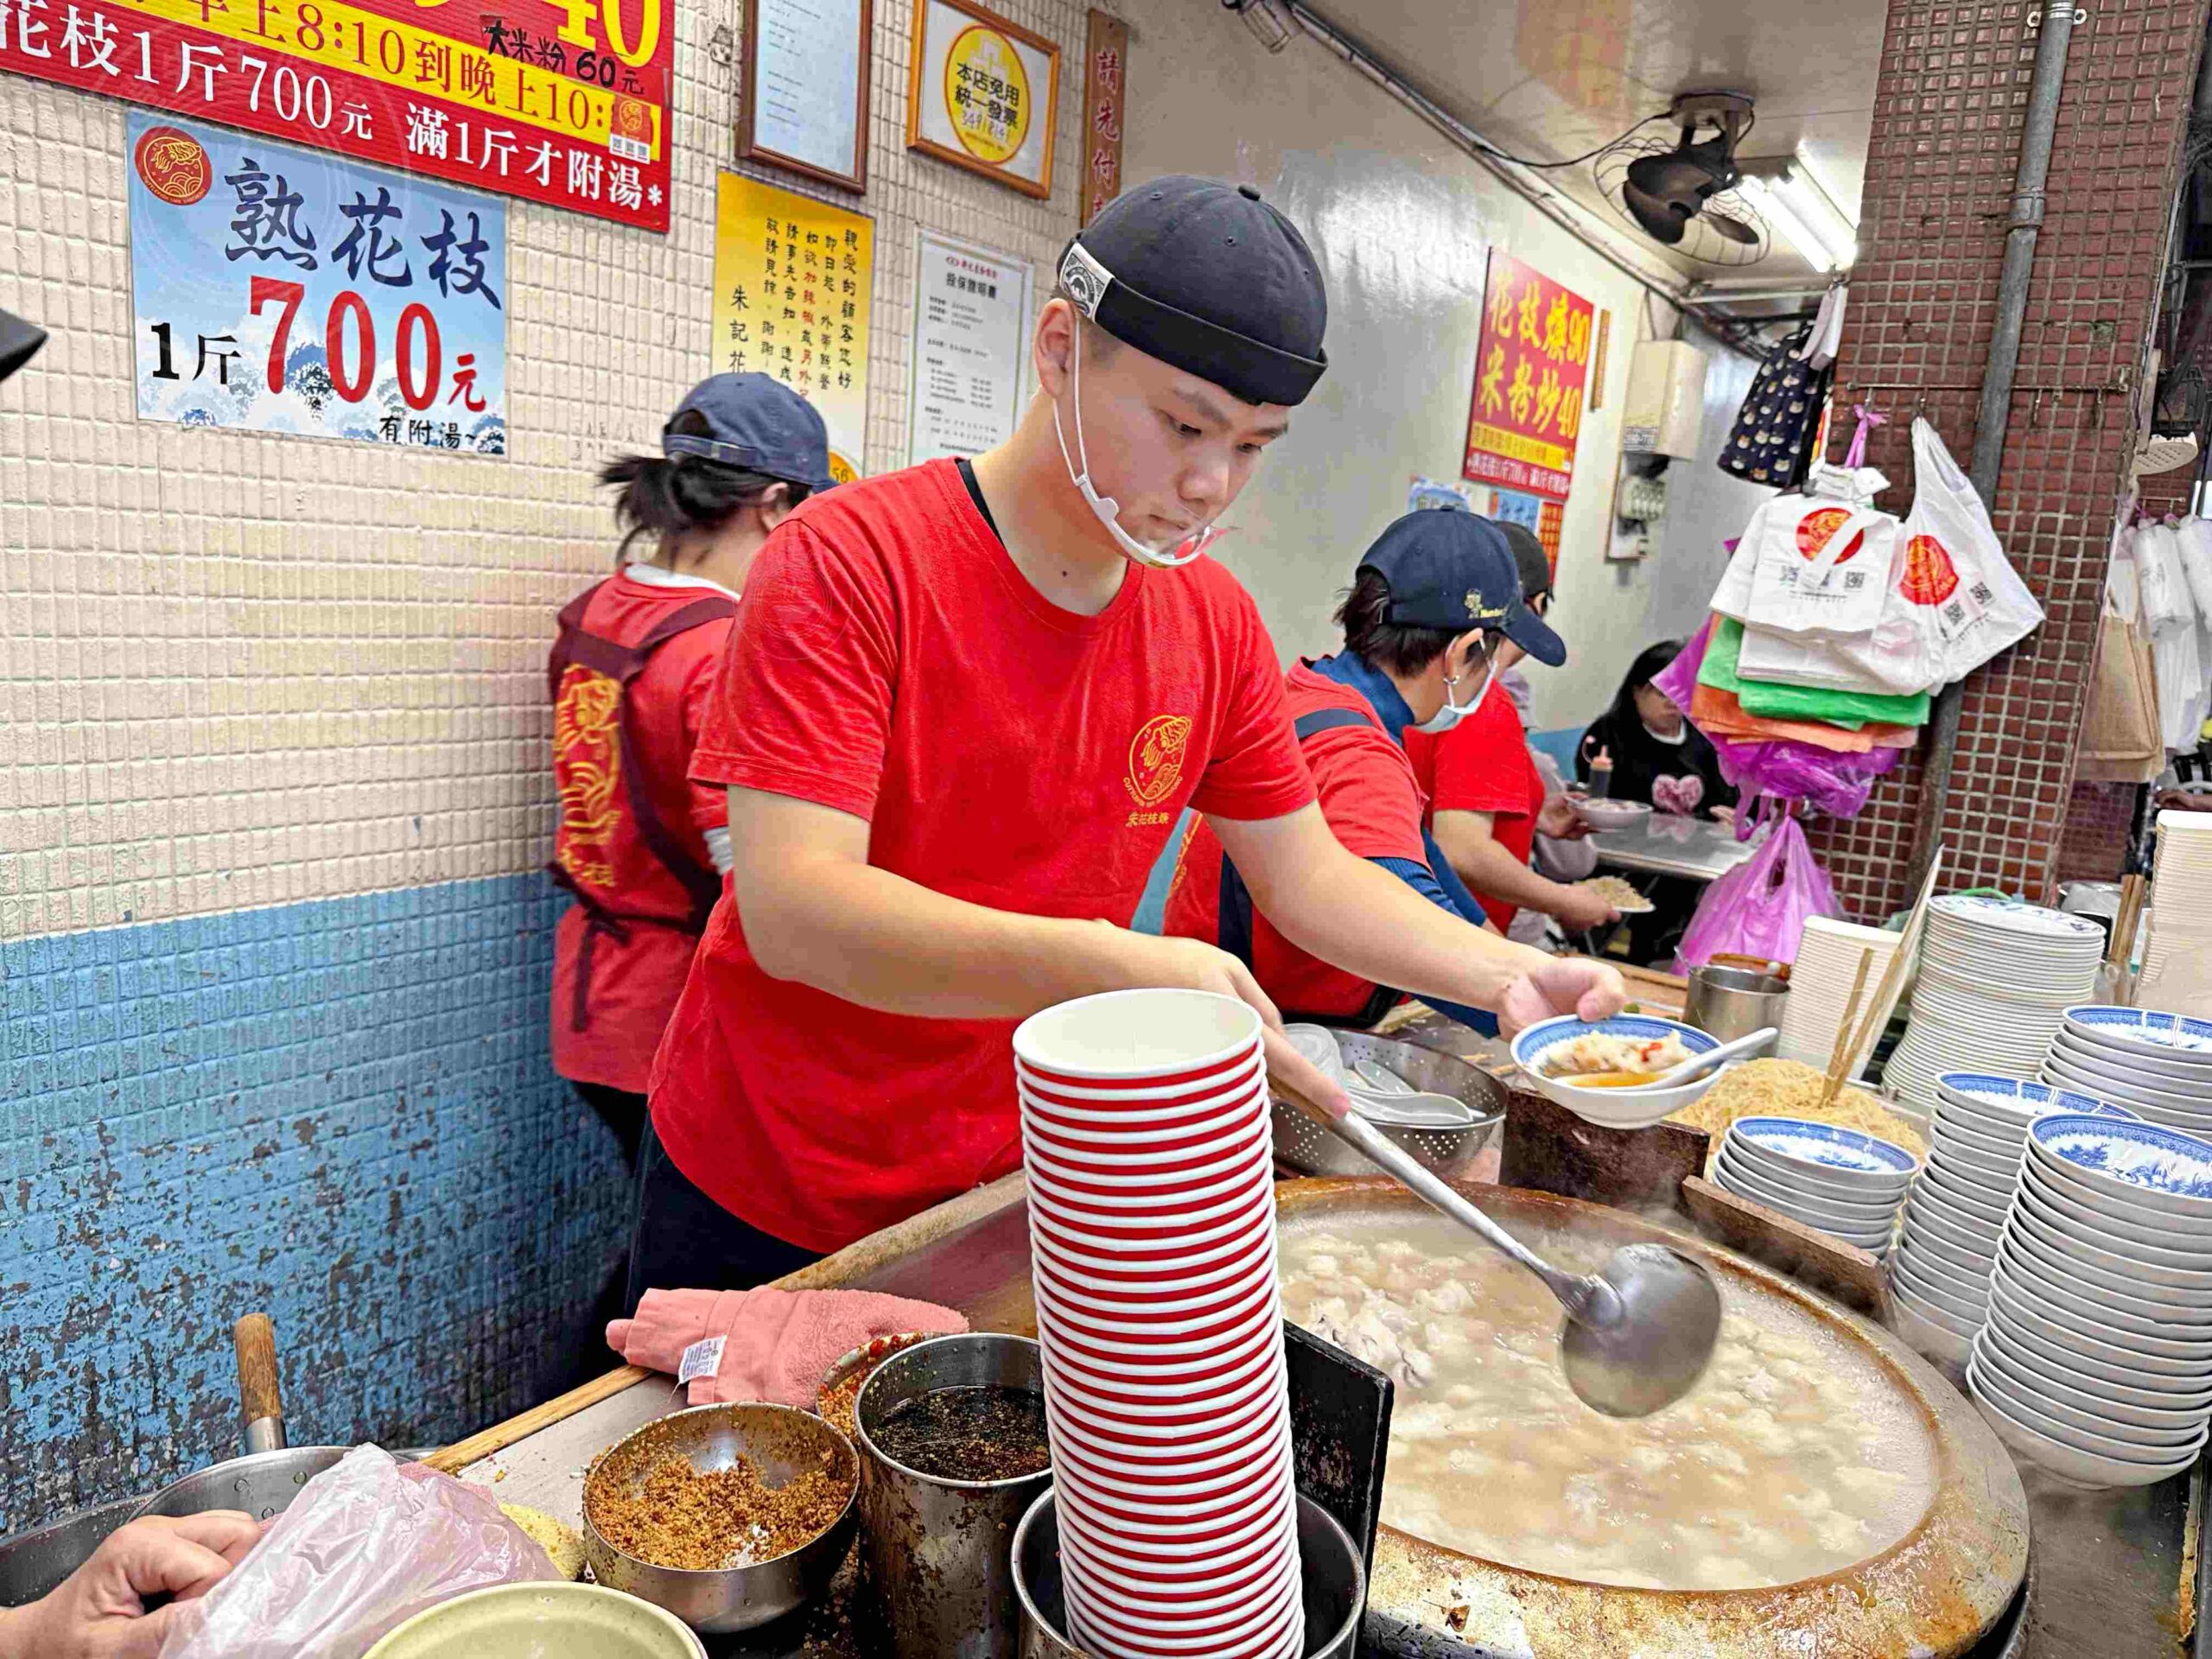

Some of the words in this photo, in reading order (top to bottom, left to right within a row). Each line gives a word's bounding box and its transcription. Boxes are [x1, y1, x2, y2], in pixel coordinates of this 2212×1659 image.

[190, 0, 654, 145] 上8:10到晚上10:
[954, 84, 1018, 129] 統一發票
[956, 62, 1020, 106] 本店免用
[225, 156, 501, 310] 熟花枝
